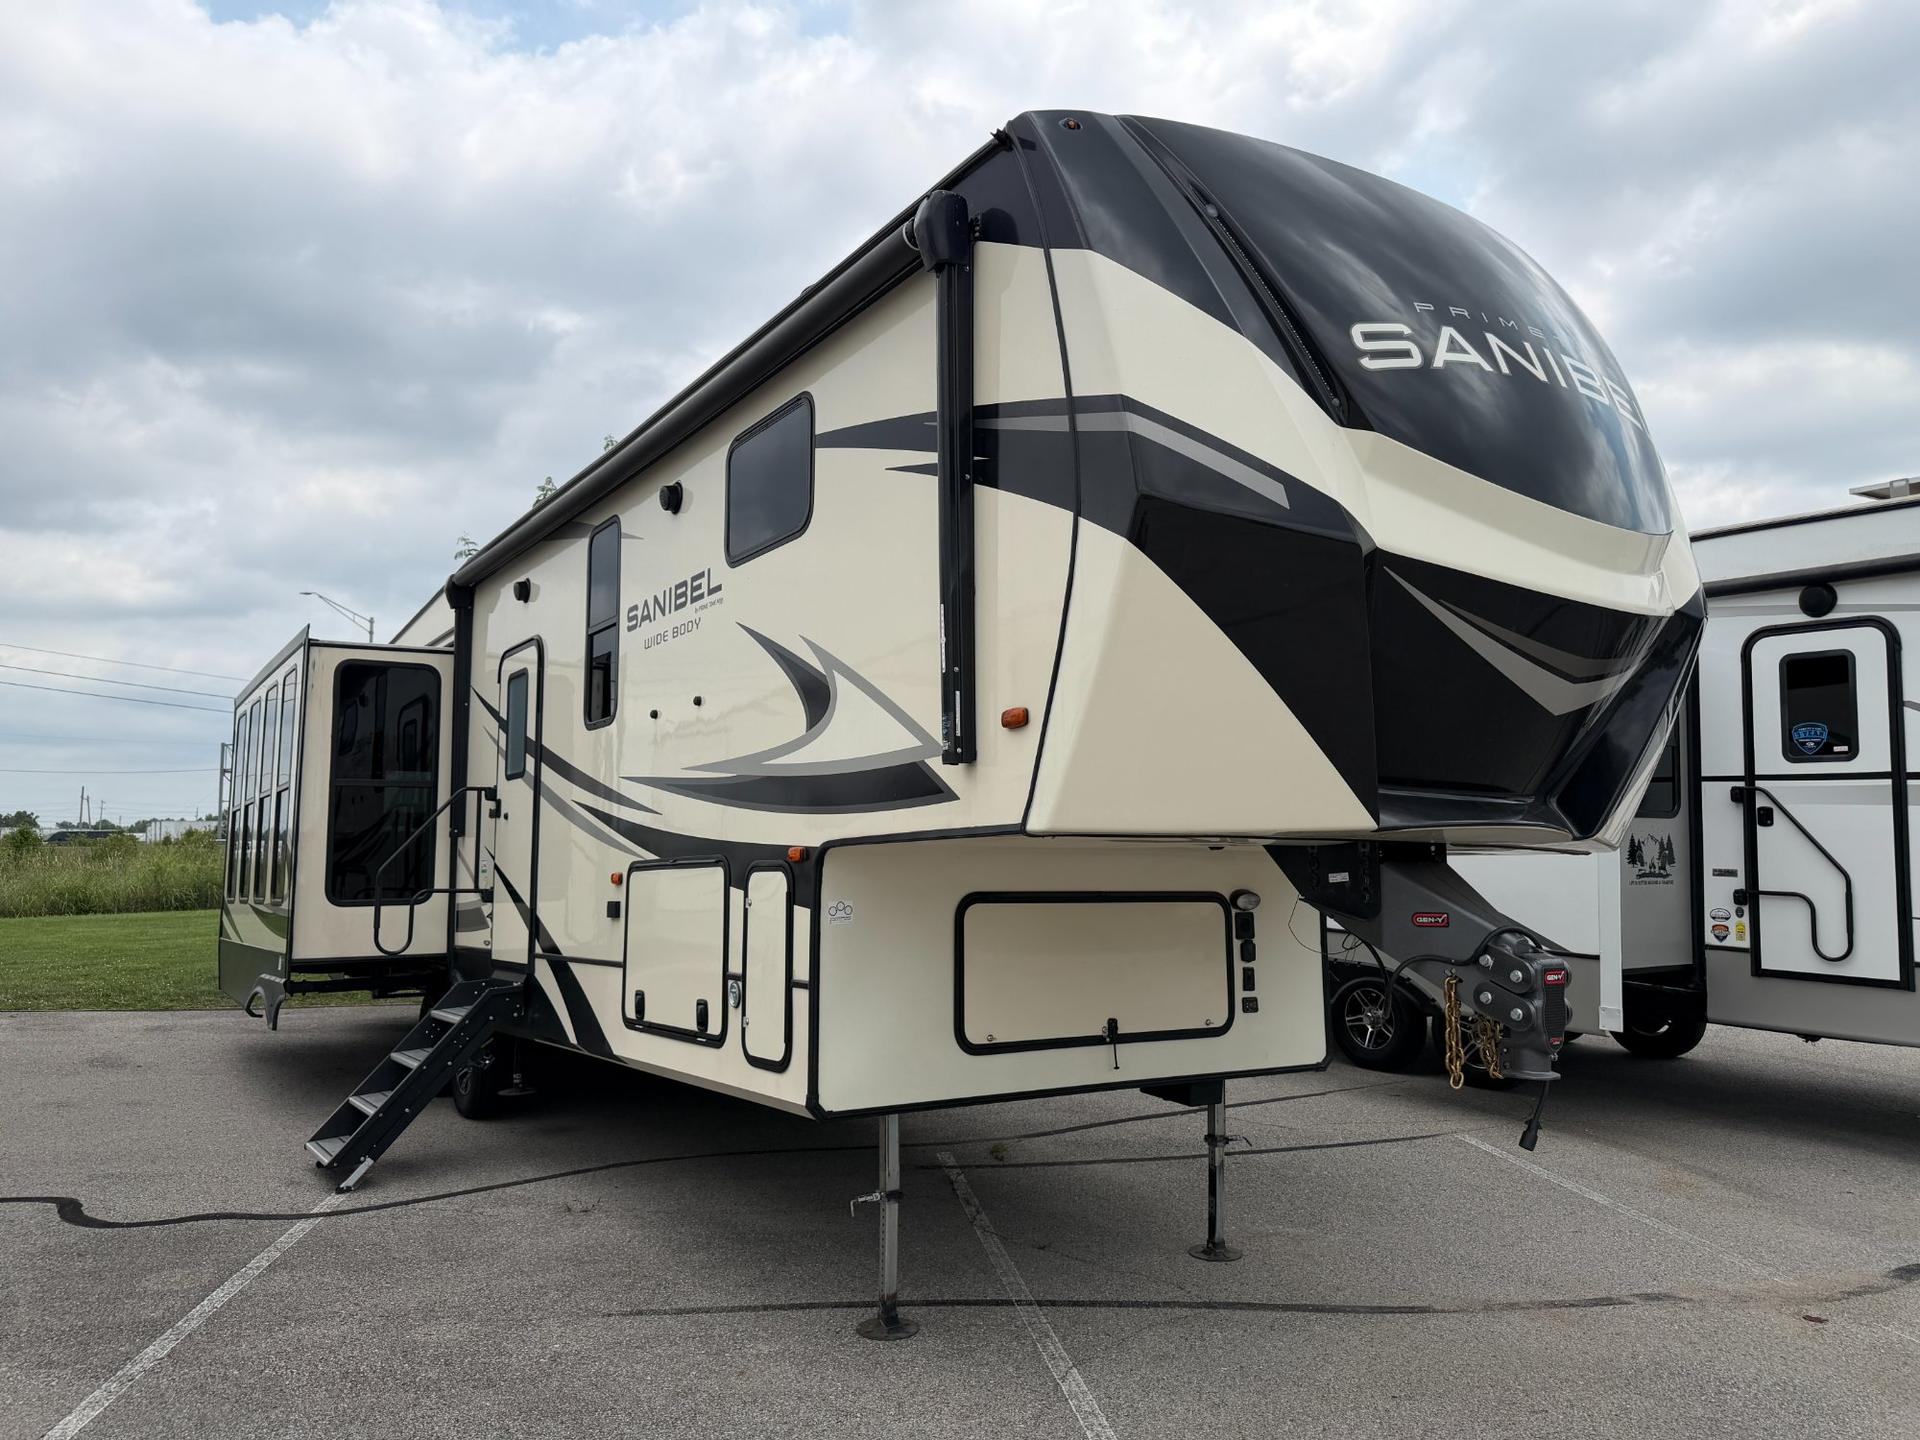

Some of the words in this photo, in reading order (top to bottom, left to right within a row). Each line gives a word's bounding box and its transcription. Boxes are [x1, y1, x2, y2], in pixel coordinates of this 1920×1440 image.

[1413, 302, 1545, 339] PRIME
[1351, 321, 1647, 431] SANIBE
[627, 568, 722, 632] SANIBEL
[644, 630, 668, 649] WIDE
[672, 617, 701, 638] BODY
[1416, 914, 1447, 923] GEN-Y
[1546, 971, 1565, 981] GEN-Y
